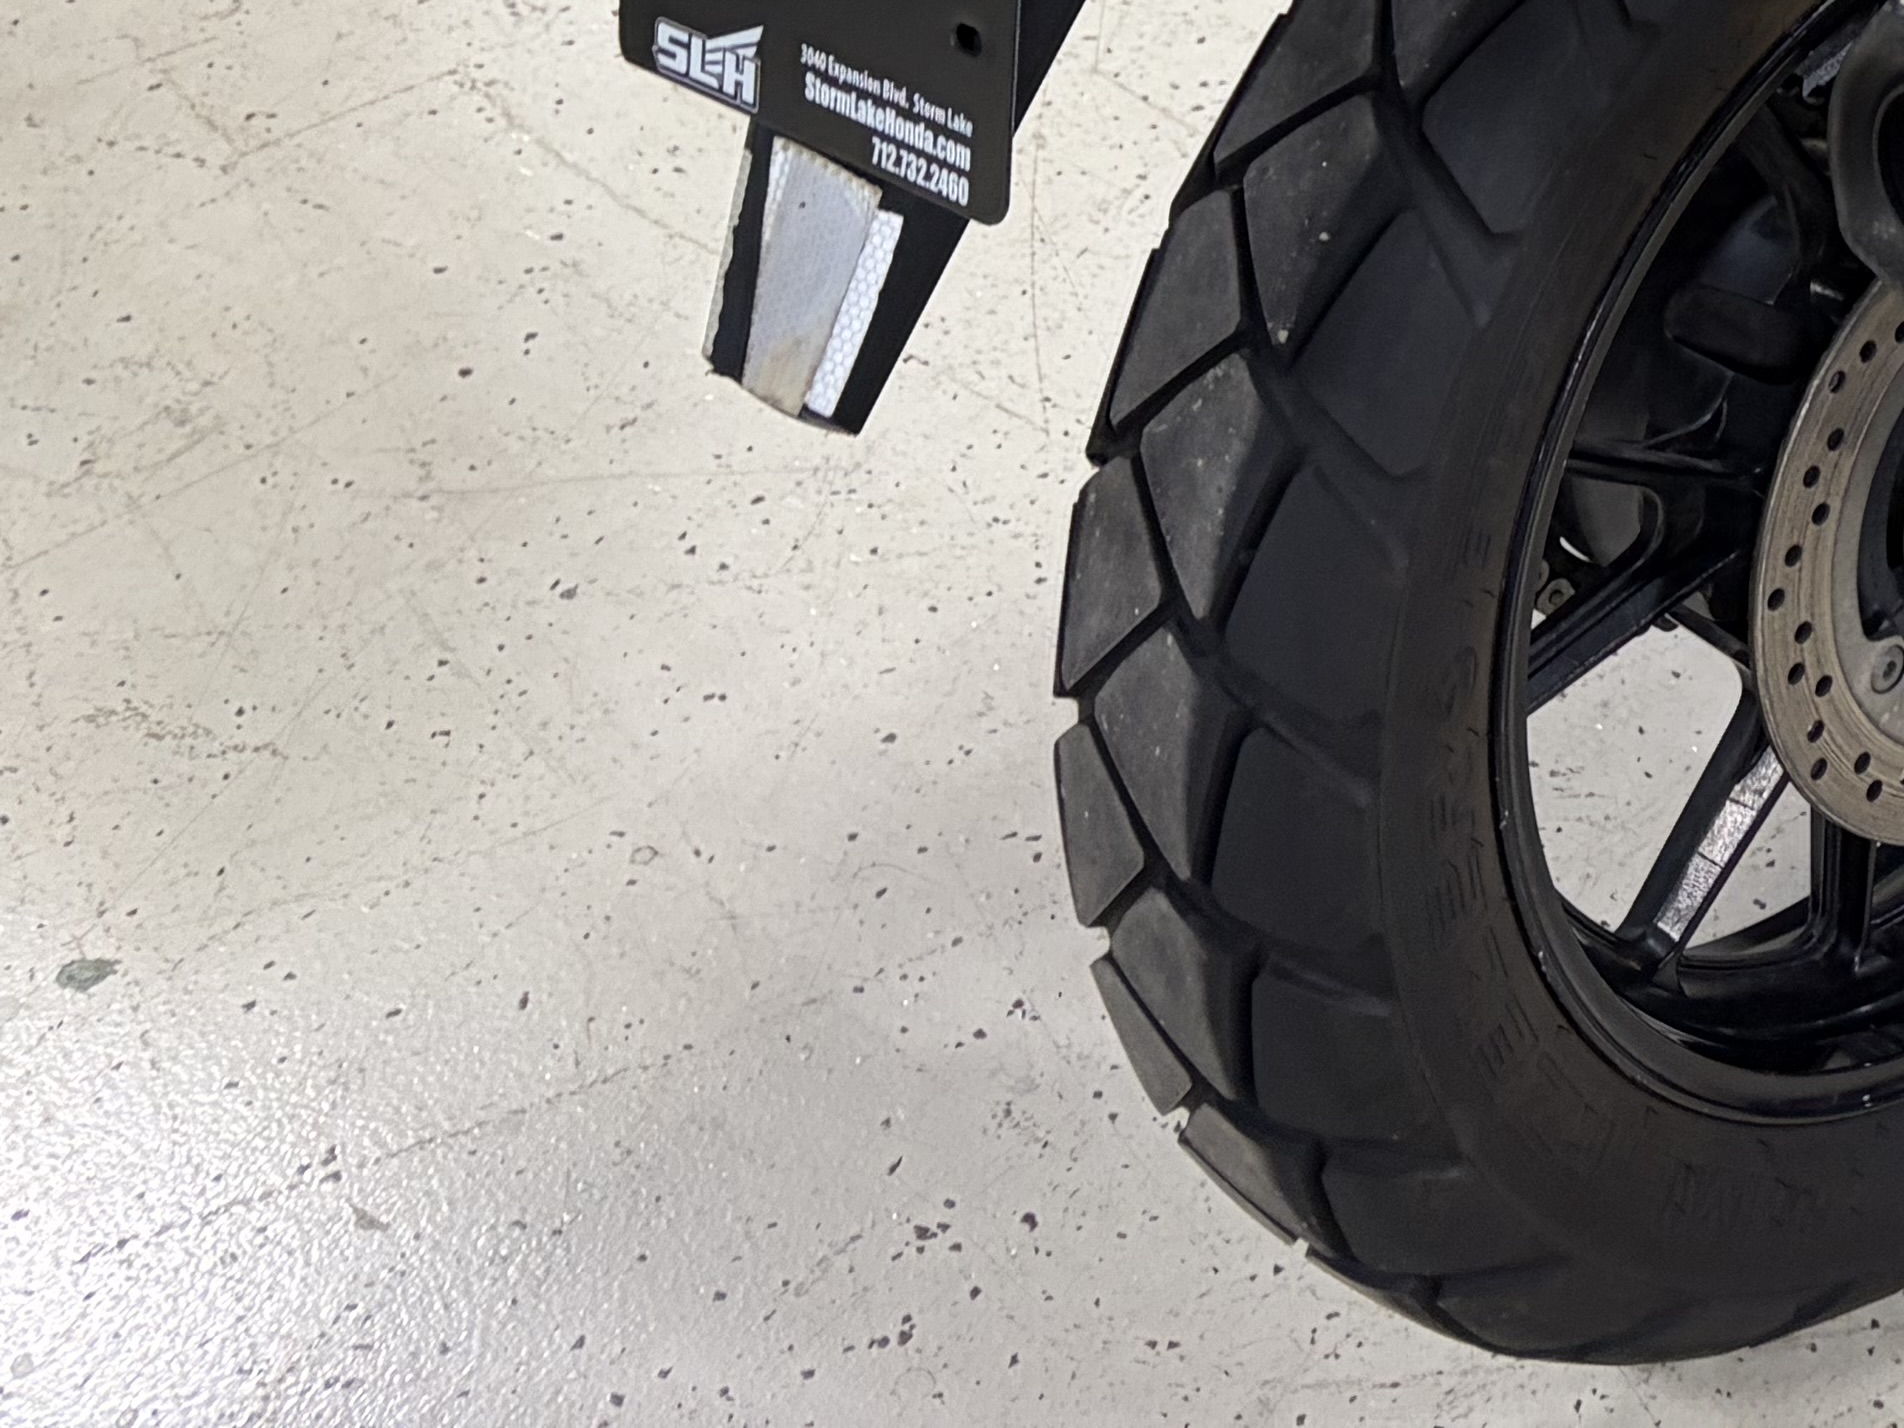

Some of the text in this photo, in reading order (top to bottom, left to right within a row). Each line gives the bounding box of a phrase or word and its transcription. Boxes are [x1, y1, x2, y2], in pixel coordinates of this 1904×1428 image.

[656, 21, 758, 106] SLH
[801, 43, 974, 139] 3040 Expansion Blvd. Storm Lake
[804, 70, 972, 173] StormLakeHonda.com
[871, 135, 970, 207] 712.732.2460
